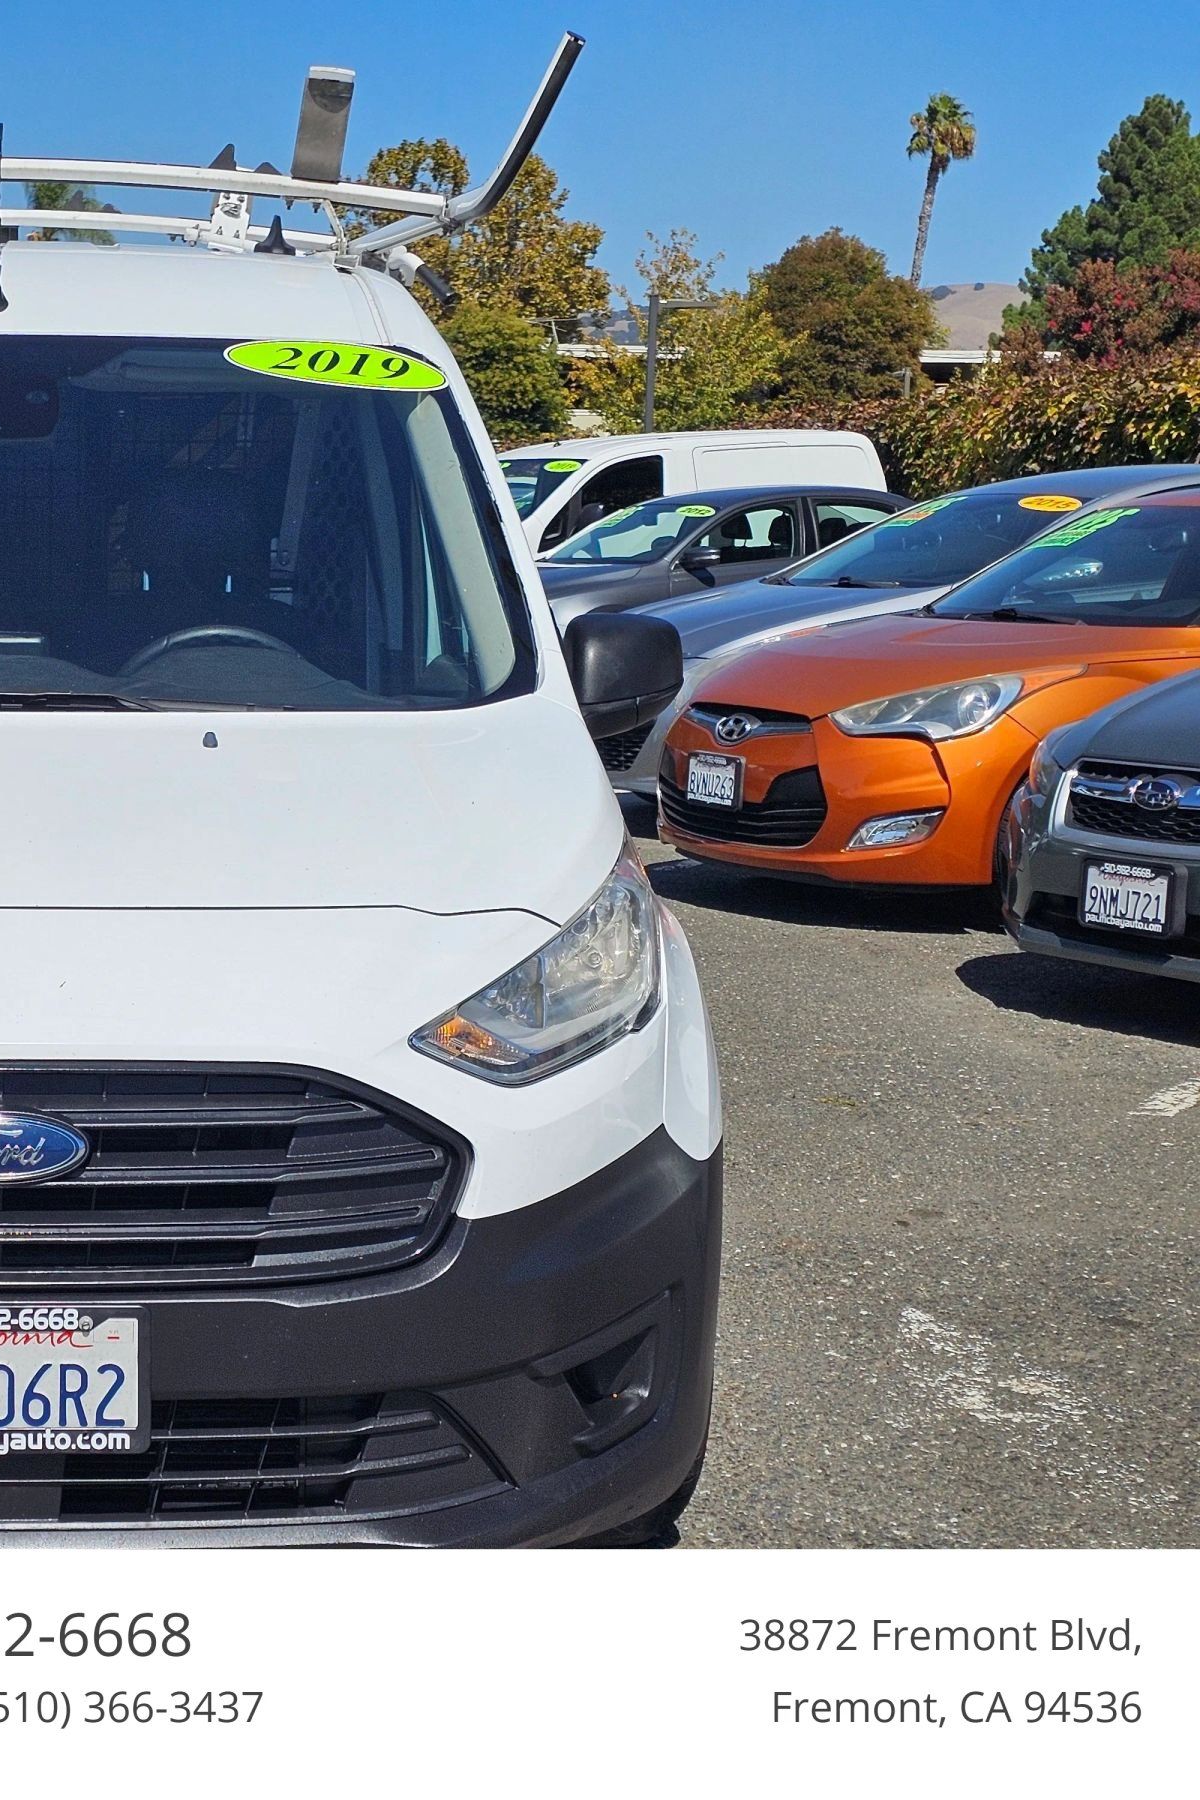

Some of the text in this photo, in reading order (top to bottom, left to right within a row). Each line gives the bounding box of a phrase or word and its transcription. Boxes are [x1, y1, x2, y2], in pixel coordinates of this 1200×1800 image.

[268, 346, 410, 379] 2019
[689, 770, 734, 798] 8VNU263
[1087, 885, 1162, 923] 9NMJ721
